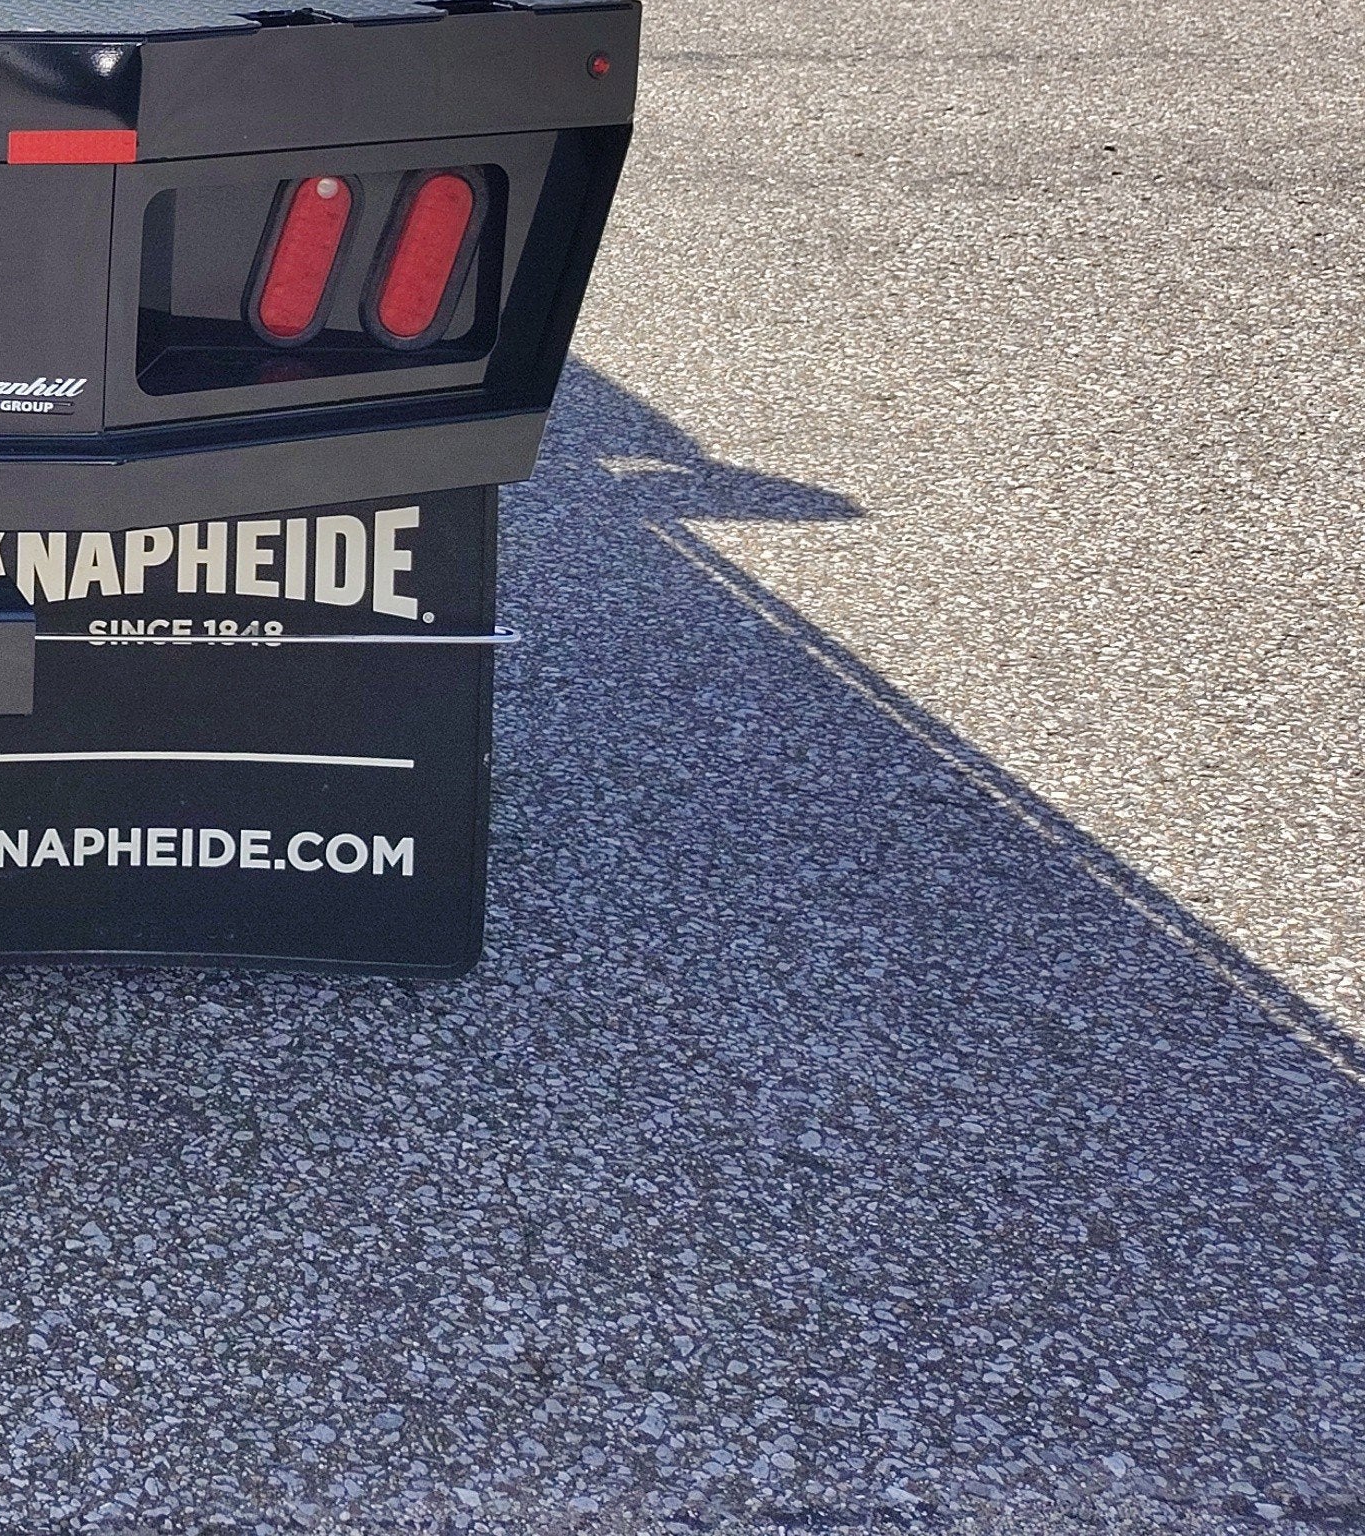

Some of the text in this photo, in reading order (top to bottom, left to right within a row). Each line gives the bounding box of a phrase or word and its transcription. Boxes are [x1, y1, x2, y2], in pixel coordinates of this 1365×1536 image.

[0, 400, 54, 413] GROUP
[88, 619, 284, 647] SINCE 1848
